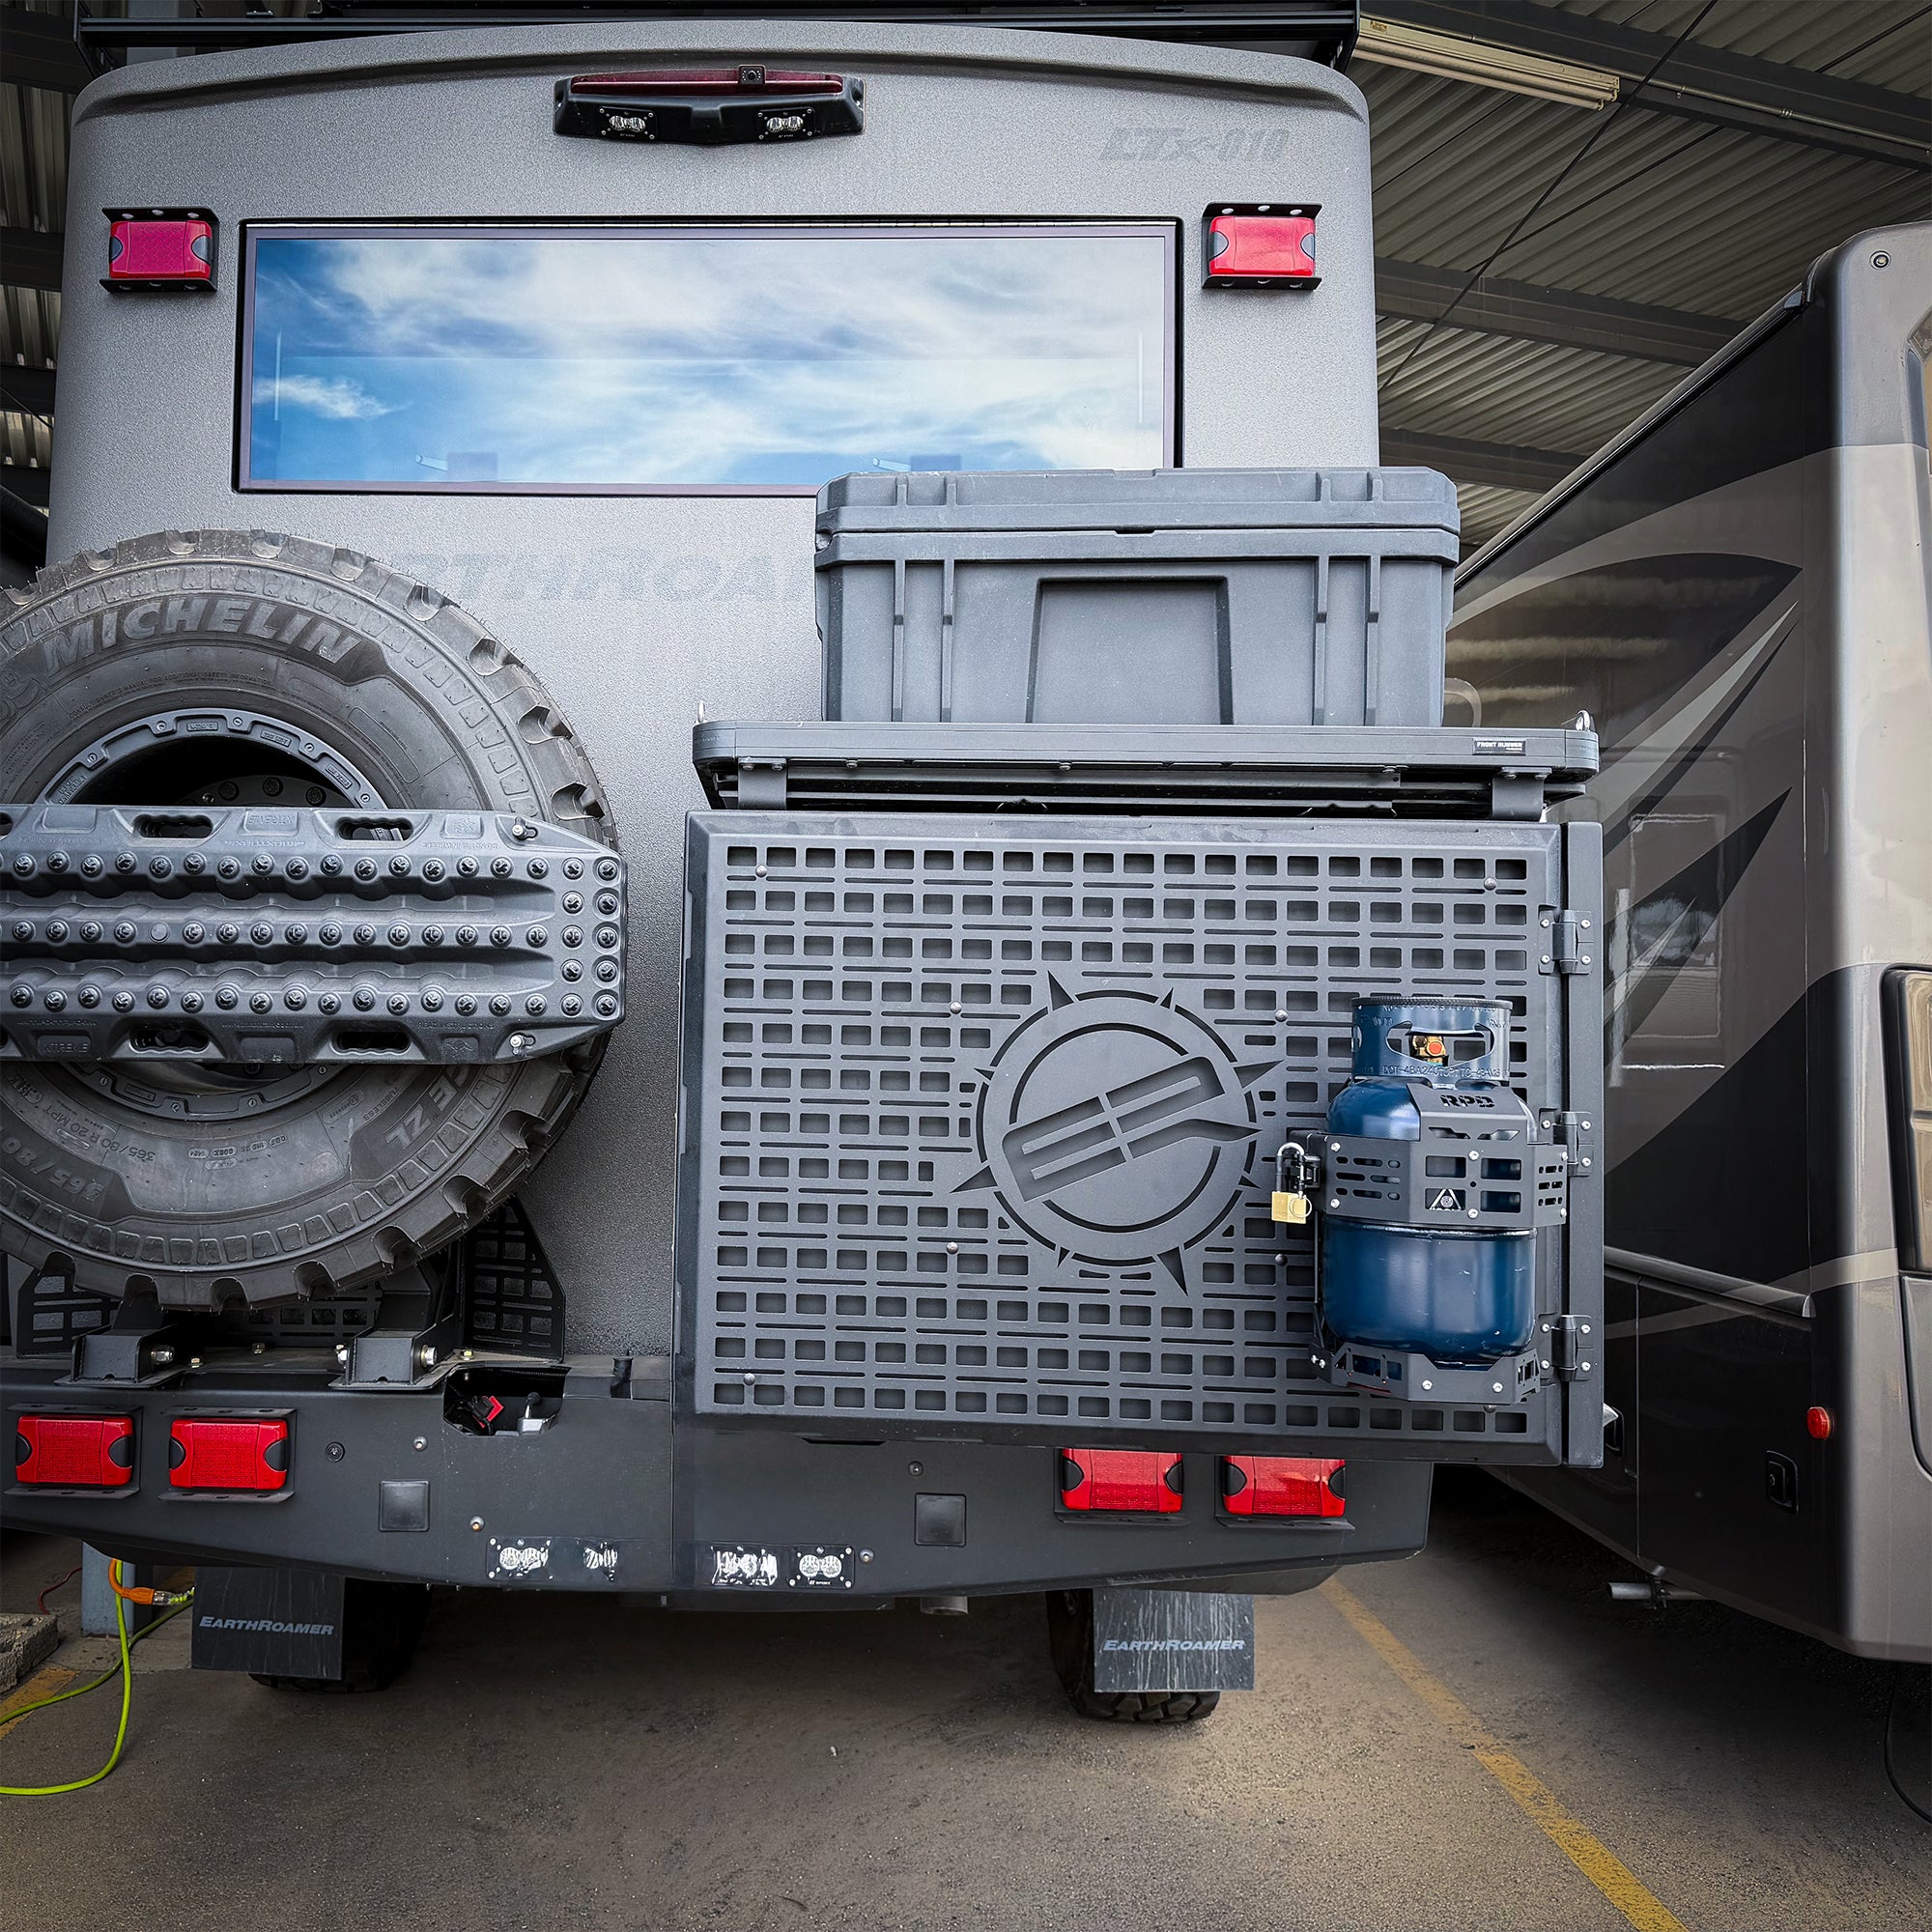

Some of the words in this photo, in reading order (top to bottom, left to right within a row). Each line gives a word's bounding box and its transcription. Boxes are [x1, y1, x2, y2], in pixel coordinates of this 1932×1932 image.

[44, 596, 362, 672] MICHELIN
[363, 1087, 400, 1122] TUBELESS
[100, 1138, 156, 1163] 365/80
[199, 1615, 334, 1635] EARTHROAMER
[1103, 1639, 1245, 1651] EARTHROAMER
